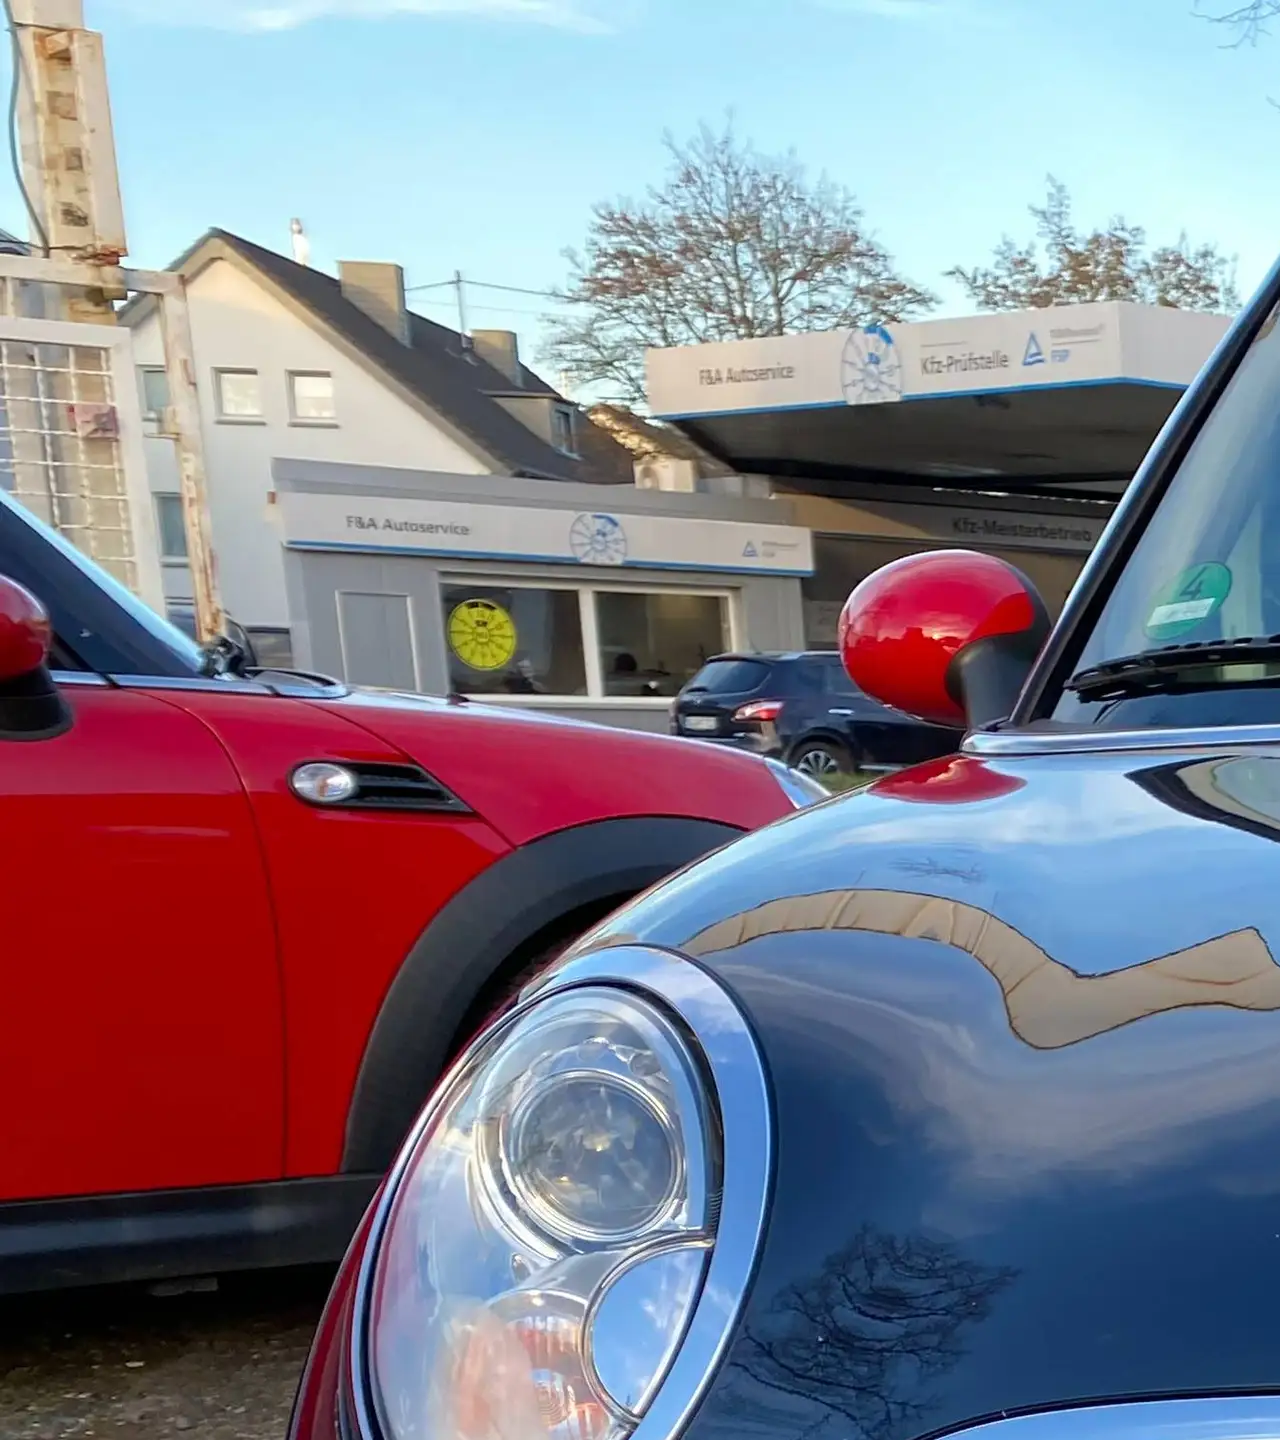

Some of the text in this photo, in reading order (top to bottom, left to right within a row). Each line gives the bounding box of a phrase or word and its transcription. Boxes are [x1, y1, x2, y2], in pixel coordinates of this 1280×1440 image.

[699, 362, 795, 386] F&A Autoservice
[920, 350, 1009, 375] Kfz-Prüfstelle
[346, 515, 471, 535] F&A Autoservice
[1179, 566, 1209, 600] 4
